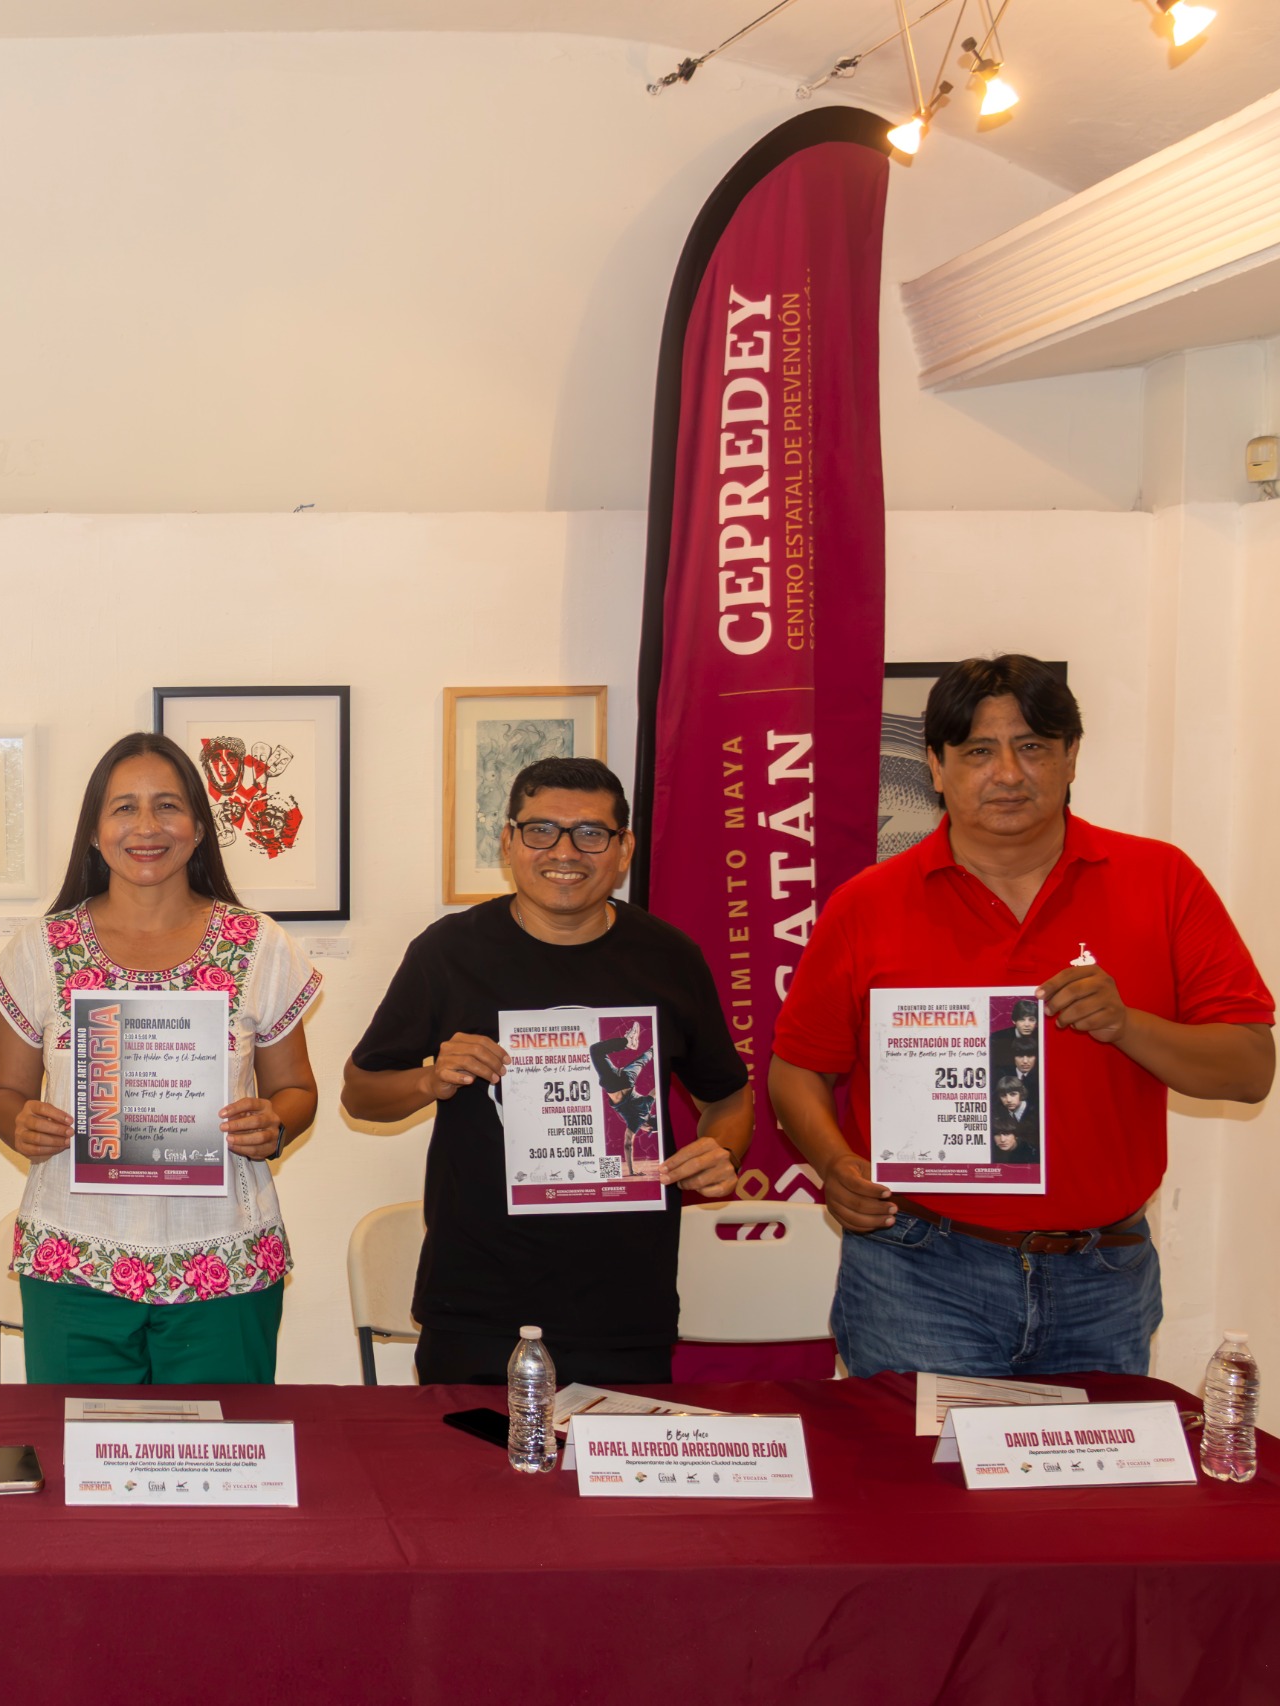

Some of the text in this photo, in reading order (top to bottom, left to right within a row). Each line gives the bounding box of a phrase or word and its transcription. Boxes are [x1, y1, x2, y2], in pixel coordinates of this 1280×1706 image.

[718, 284, 772, 655] CEPREDEY
[778, 293, 805, 650] CENTRO ESTATAL DE PREVENCIÓN
[723, 734, 756, 1080] ACIMIENTO MAYA
[125, 1017, 190, 1029] PROGRAMACIÓN
[892, 1011, 977, 1027] SINERGIA
[124, 1042, 196, 1051] TALLER DE BREAK DANCE
[510, 1032, 587, 1049] SINERGIA
[888, 1036, 986, 1048] PRESENTACIÓN DE ROCK
[512, 1054, 590, 1065] TALLER DE BREAK DANCE
[77, 1028, 86, 1135] ENCUENTRO DE ARTE URBANO
[88, 1004, 120, 1160] SINERGIA
[125, 1078, 169, 1087] PRESENTACIÓN
[935, 1067, 986, 1088] 25.09
[544, 1081, 590, 1102] 25.09
[955, 1102, 987, 1113] TEATRO
[125, 1113, 195, 1123] PRESENTACIÓN DE ROCK
[563, 1115, 592, 1126] TEATRO
[548, 1127, 593, 1136] FELIPE CARRILLO
[964, 1123, 987, 1131] PUERTO
[943, 1134, 986, 1145] 7:30 P.M.
[529, 1147, 595, 1159] 3:00 A 5:00 P.M.
[1004, 1428, 1135, 1448] DAVID ÁVILA MONTALVO
[95, 1443, 266, 1459] MTRA. ZAYURI VALLE VALENCIA
[588, 1440, 787, 1458] RAFAEL ALFREDO ARREDONDO REJÓN
